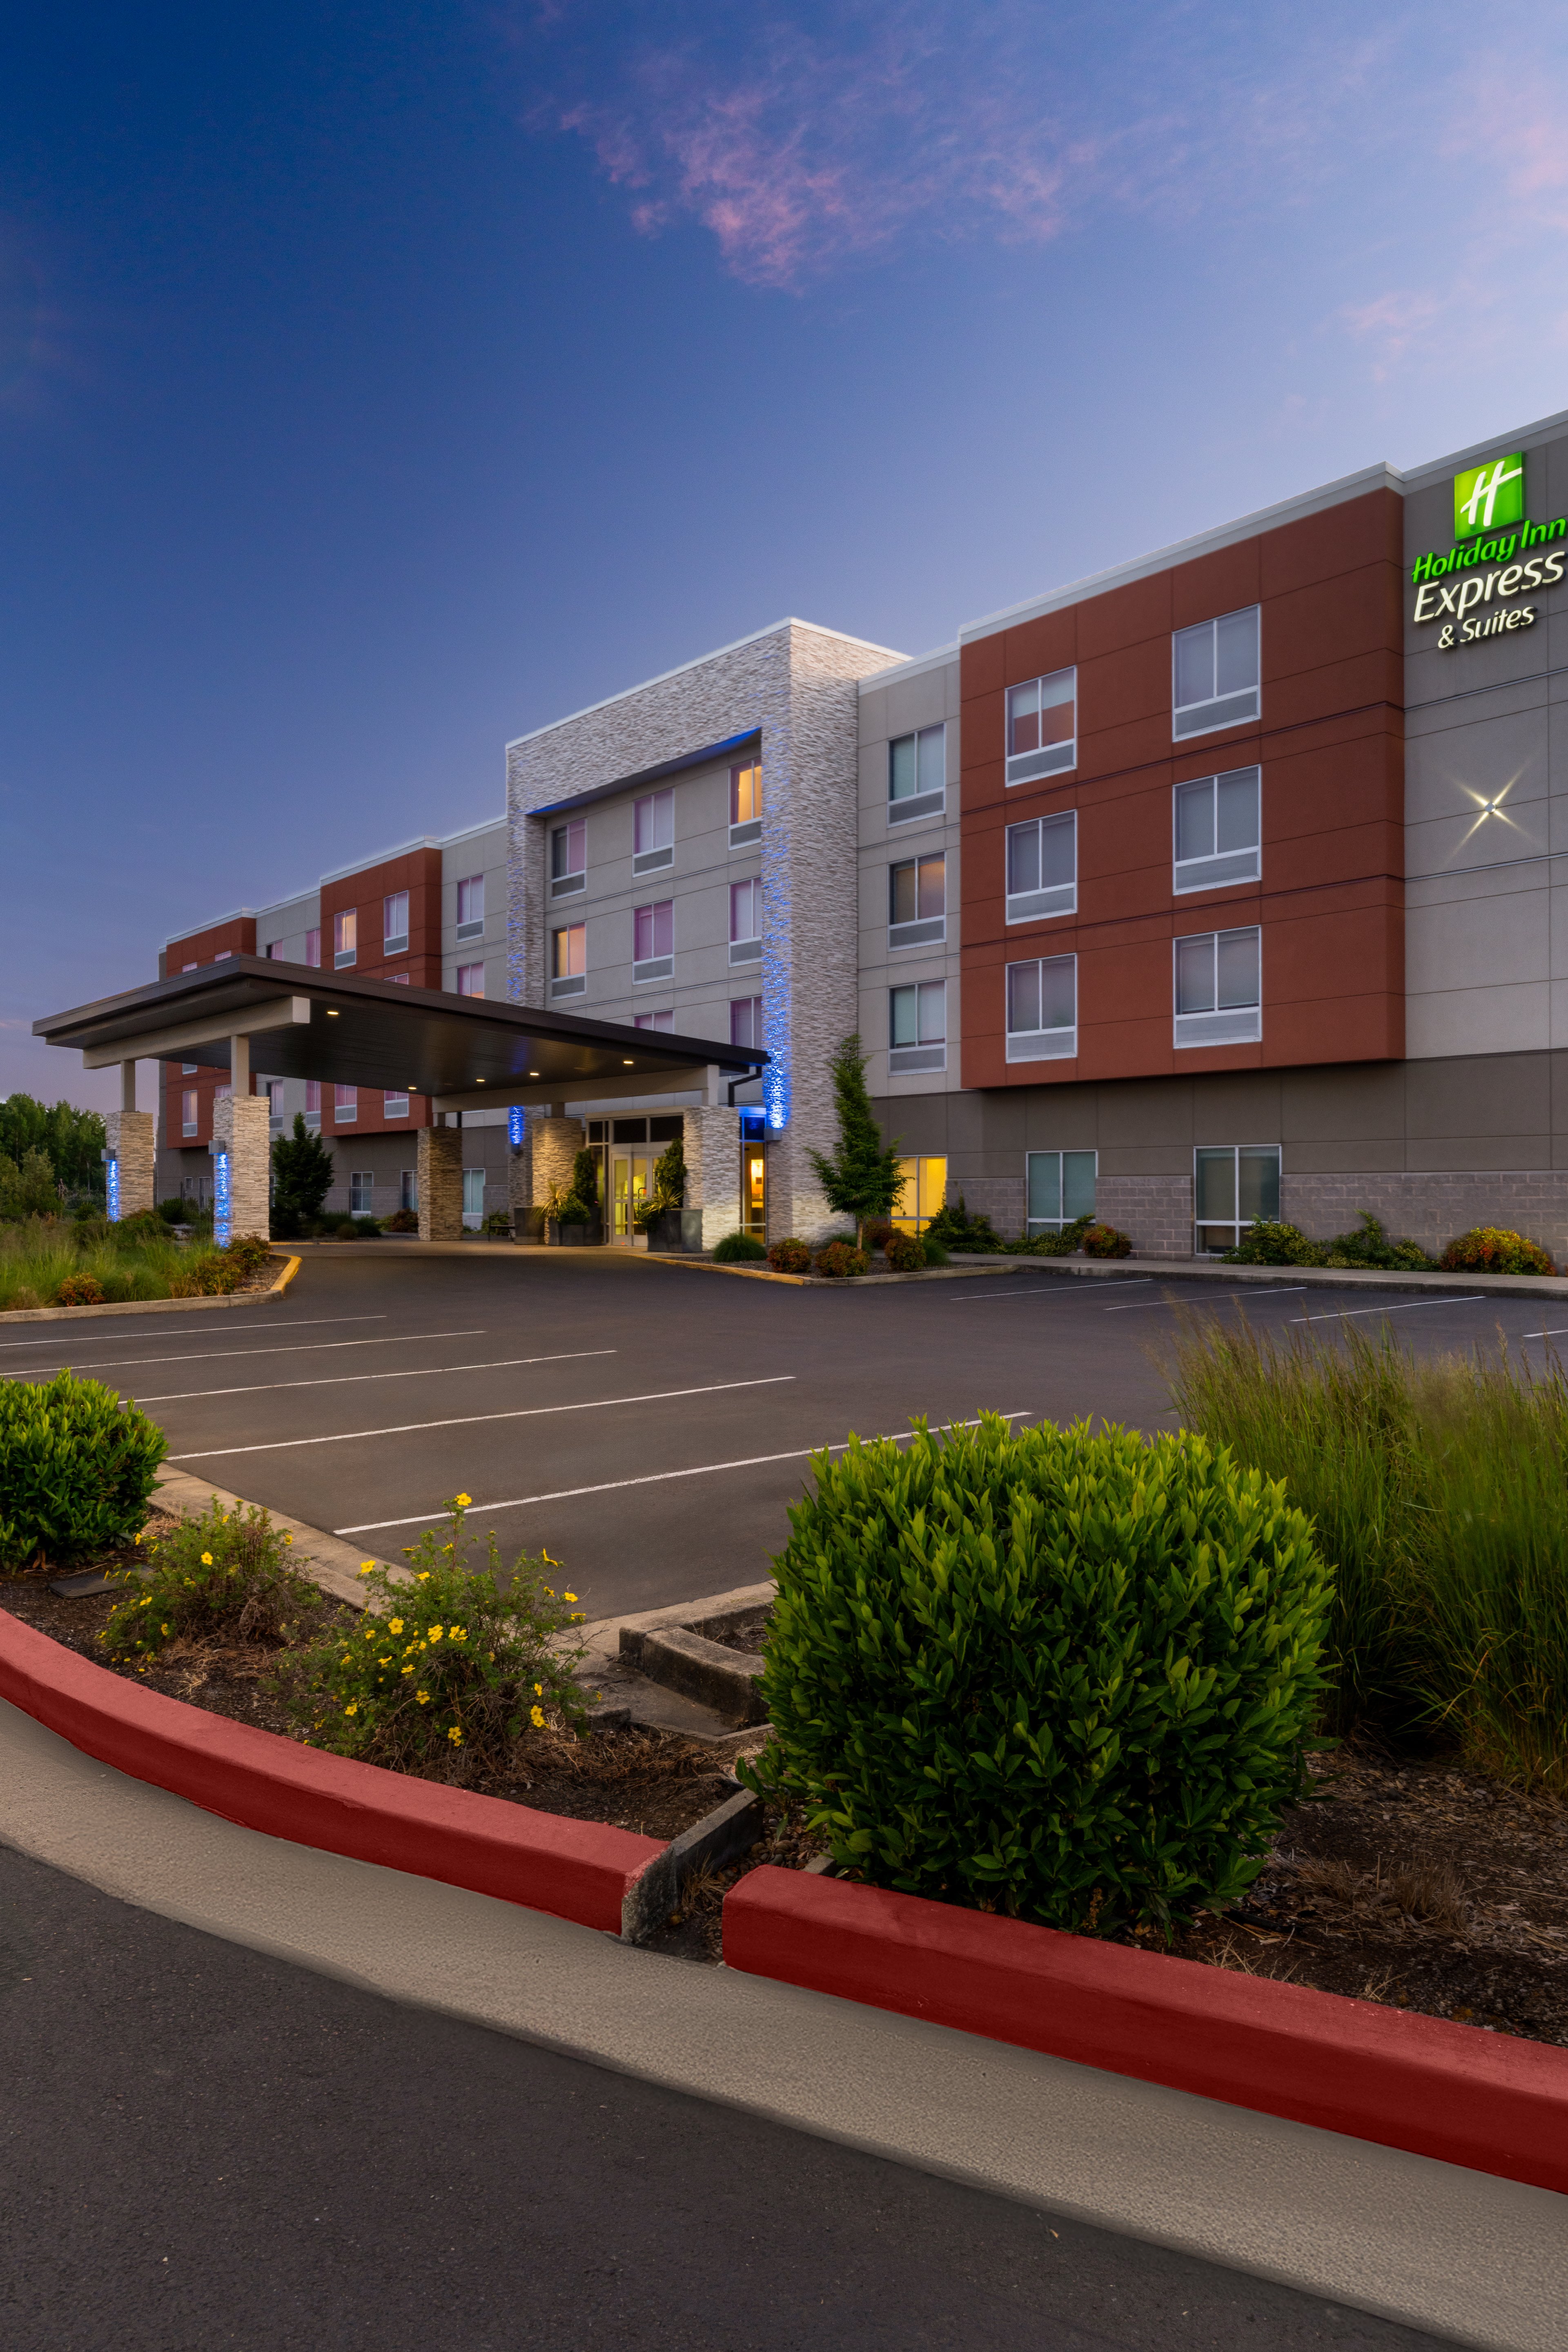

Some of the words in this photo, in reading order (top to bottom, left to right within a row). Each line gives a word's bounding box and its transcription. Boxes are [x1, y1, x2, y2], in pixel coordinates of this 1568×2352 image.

[1460, 461, 1522, 527] H
[1411, 534, 1517, 583] Holiday
[1521, 518, 1566, 548] Inn
[1414, 551, 1566, 622] Express
[1438, 624, 1454, 649] &
[1460, 606, 1535, 643] Suites
